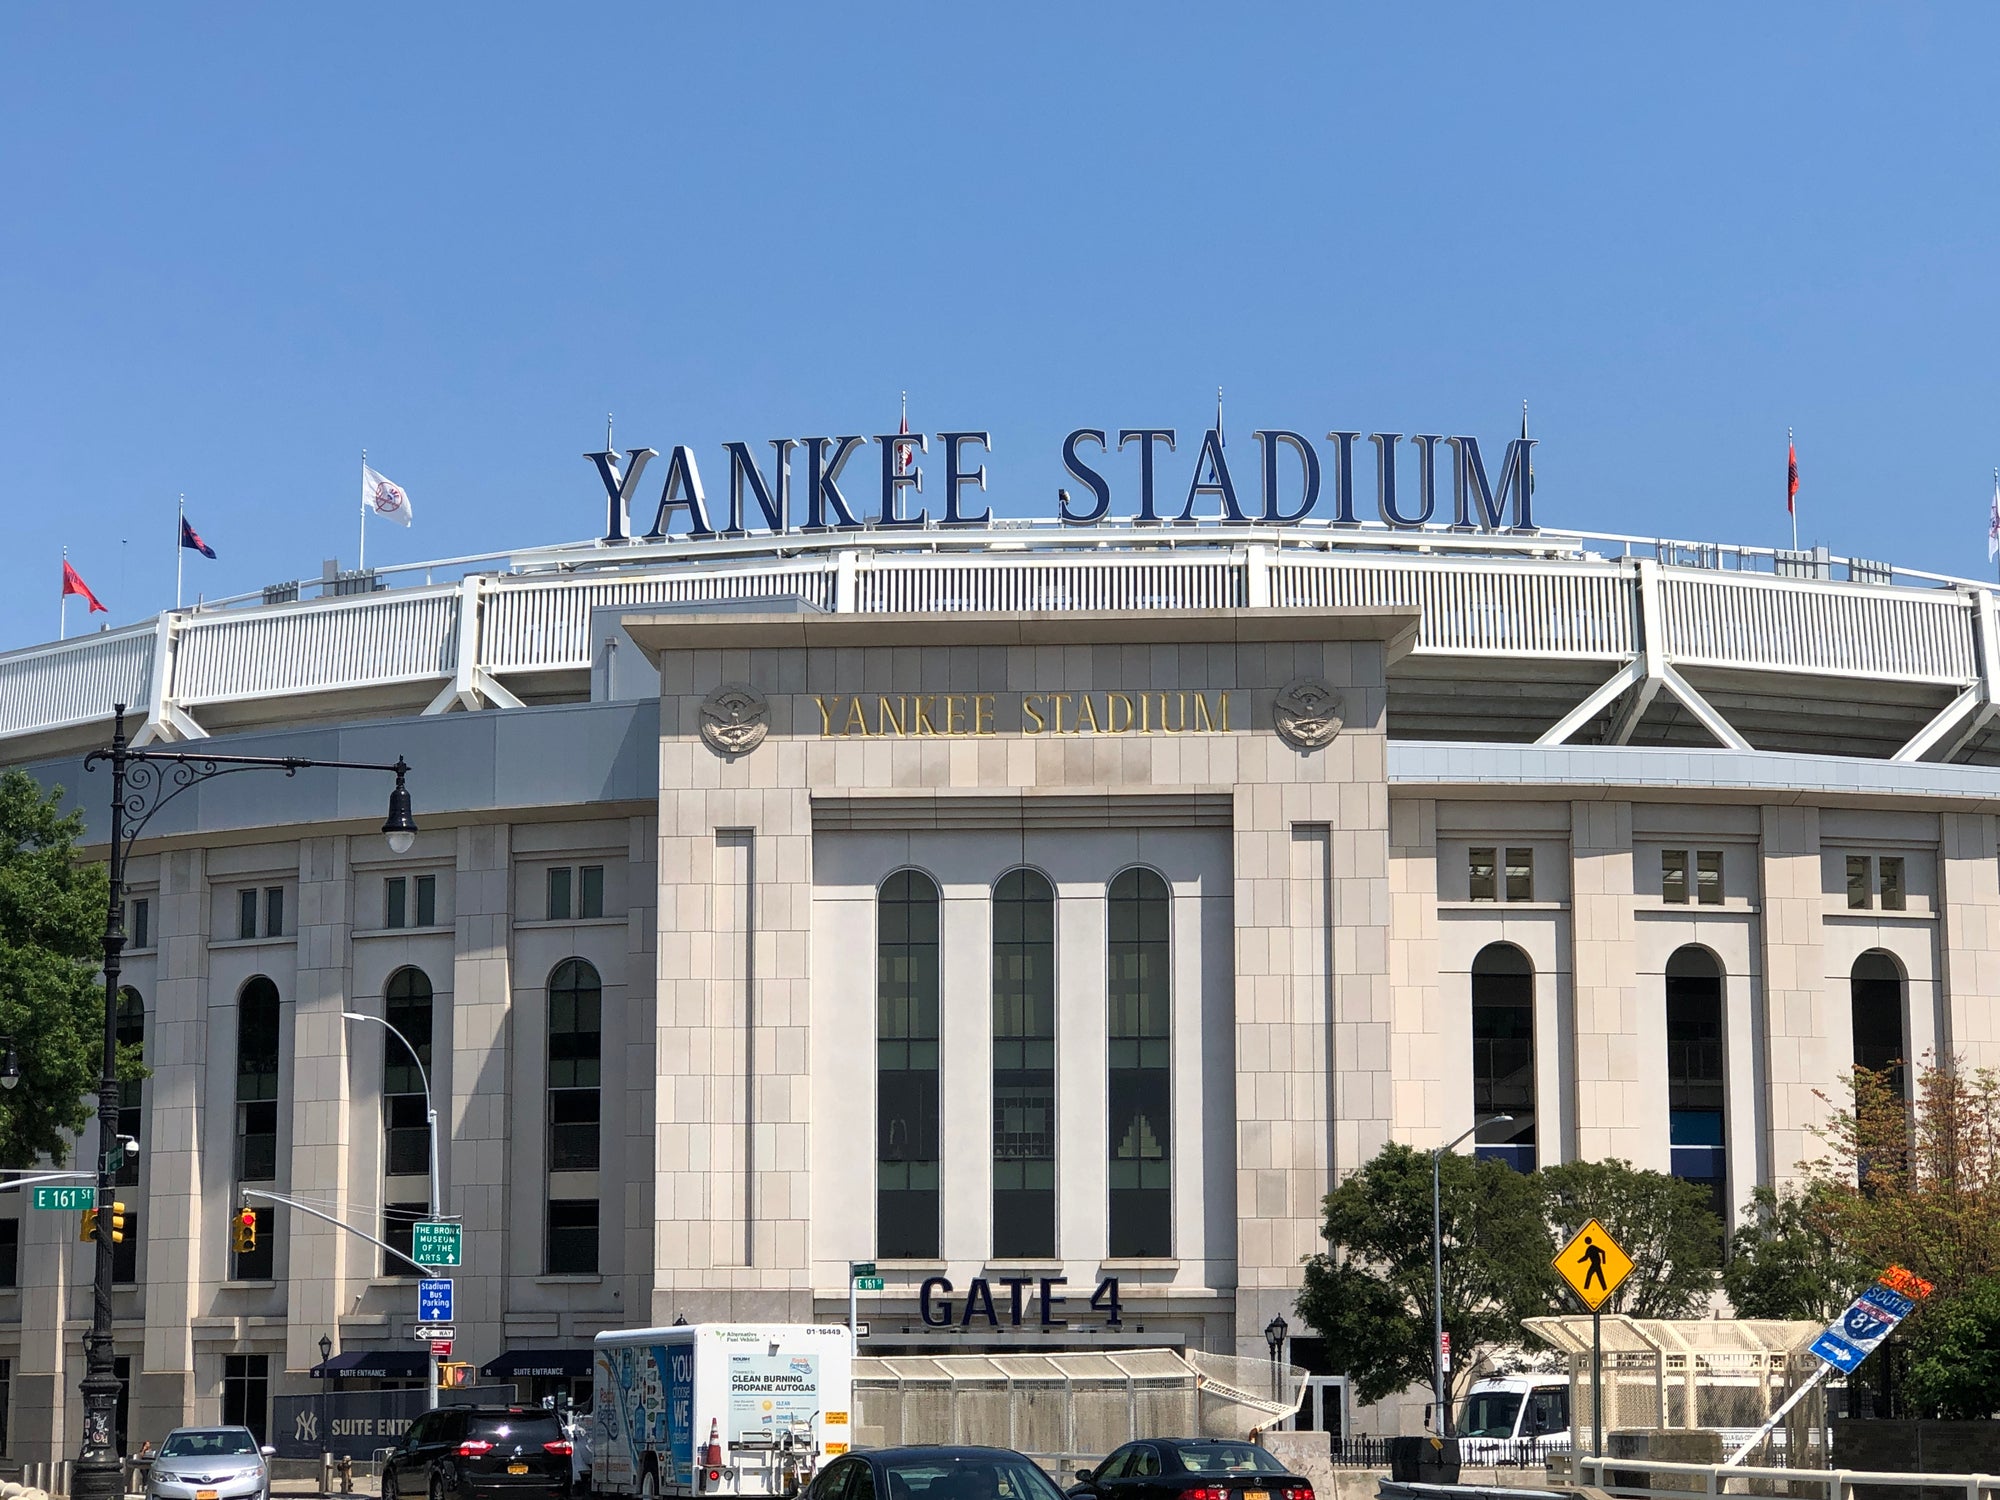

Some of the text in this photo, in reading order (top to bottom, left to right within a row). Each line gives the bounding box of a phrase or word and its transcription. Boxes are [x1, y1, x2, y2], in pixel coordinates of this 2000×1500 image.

[583, 428, 1540, 542] YANKEE STADIUM
[814, 692, 1233, 738] YANKEE STADIUM
[38, 1189, 91, 1207] E 161 St
[416, 1226, 460, 1235] THE BRONX
[420, 1235, 455, 1243] MUSEUM
[422, 1244, 453, 1252] OF THE
[419, 1253, 441, 1262] ARTS
[421, 1282, 451, 1291] Stadium
[864, 1279, 876, 1289] 161
[429, 1290, 443, 1299] Bus
[422, 1299, 450, 1309] Parking
[919, 1276, 1123, 1328] GATE 4
[1867, 1286, 1914, 1316] SOUTH
[1850, 1313, 1881, 1334] 87
[340, 1369, 386, 1377] SUITE ENTRANCE
[513, 1368, 564, 1376] SUITE ENTRANCE
[672, 1354, 692, 1383] YOU
[732, 1375, 803, 1383] CLEAN BURNING
[732, 1384, 816, 1392] PROPANE AUTOGAS
[673, 1400, 689, 1428] WE
[331, 1419, 372, 1436] SUITE
